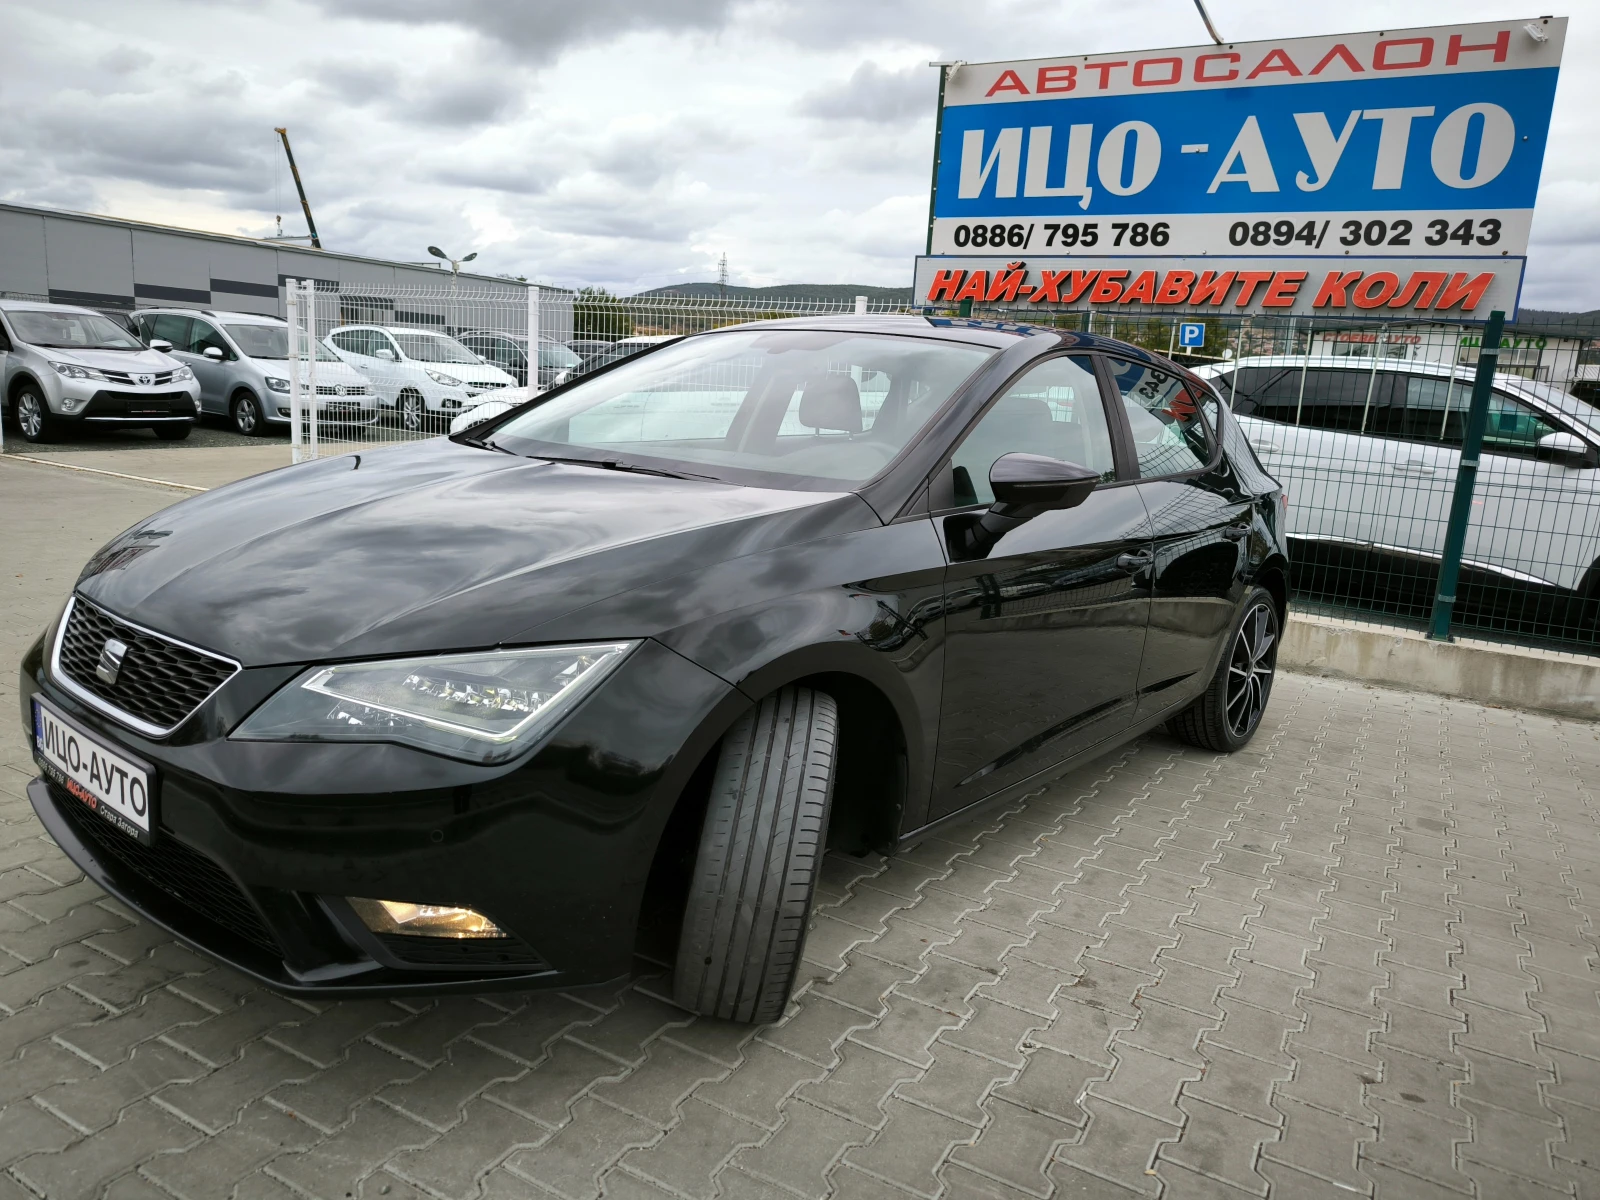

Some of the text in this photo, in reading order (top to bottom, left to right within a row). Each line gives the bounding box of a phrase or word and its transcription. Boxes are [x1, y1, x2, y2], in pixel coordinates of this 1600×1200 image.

[985, 30, 1511, 97] АВТОСАЛОН
[953, 222, 1170, 249] 0886/ 795 786
[1228, 218, 1502, 249] 0894/ 302 343
[927, 262, 1495, 311] НАЙ-ХУБАВИТЕ КОЛИ
[1185, 326, 1199, 343] P
[43, 716, 147, 817] ИЦО-АУТО
[100, 805, 117, 824] Стара
[117, 817, 139, 838] Загора
